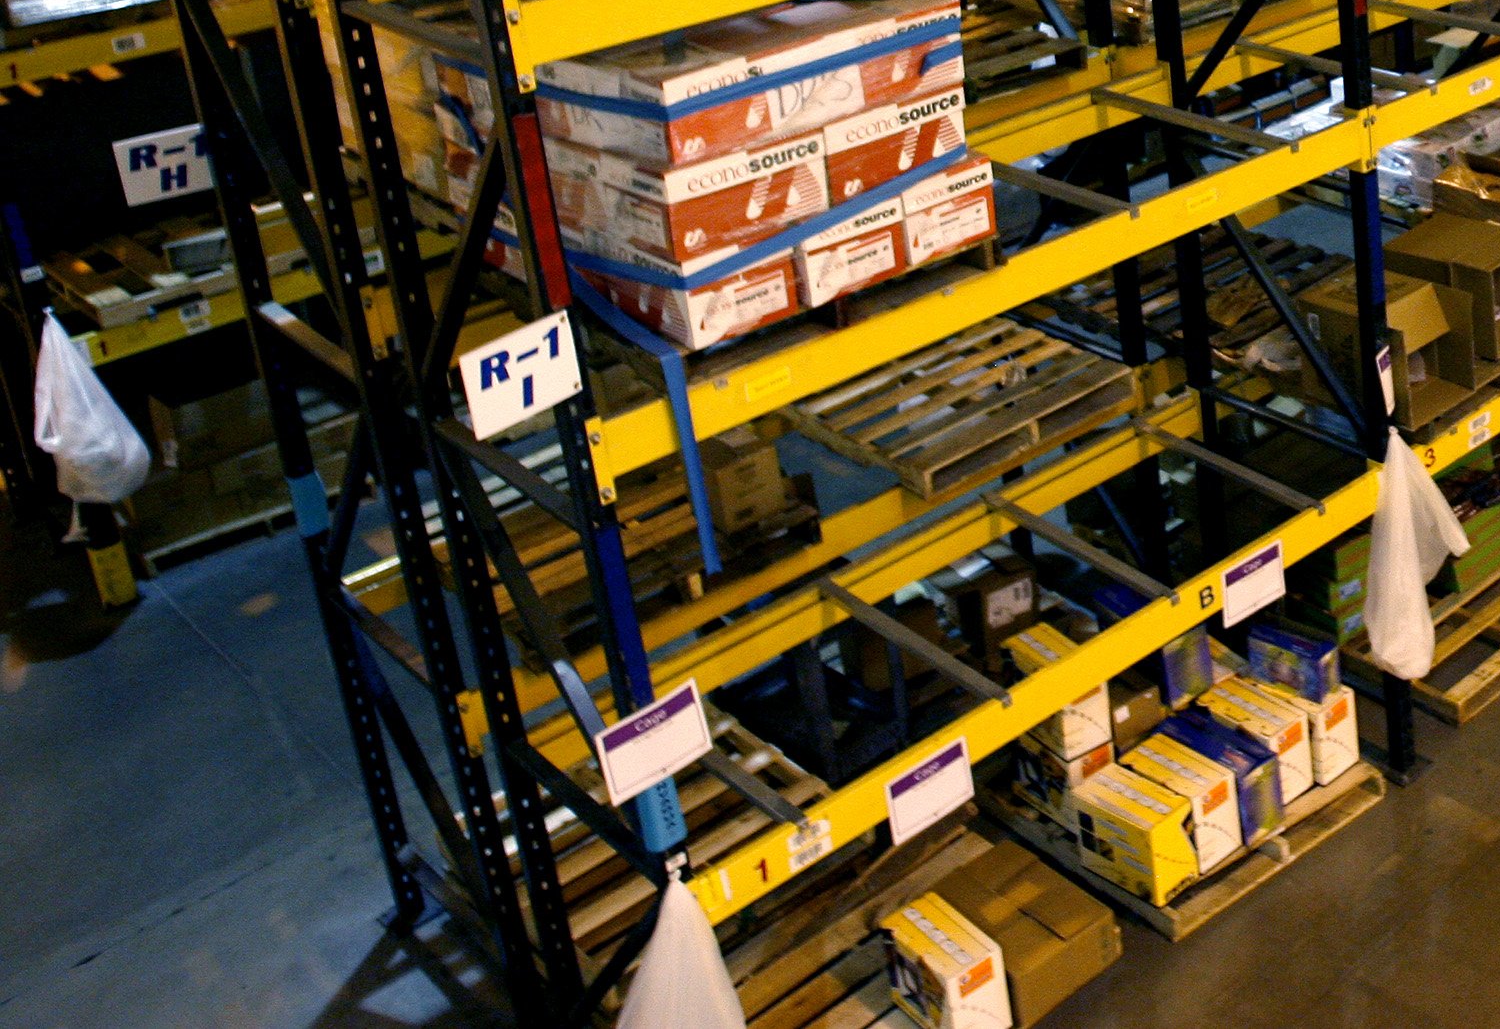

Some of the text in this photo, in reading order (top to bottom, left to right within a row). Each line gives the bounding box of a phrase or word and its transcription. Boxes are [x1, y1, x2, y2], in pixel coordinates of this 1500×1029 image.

[846, 92, 960, 143] econosource
[160, 163, 188, 192] H
[687, 139, 820, 192] econosource
[480, 326, 560, 392] R-1
[1424, 448, 1437, 468] 3
[1199, 585, 1214, 609] B
[755, 858, 768, 882] 1
